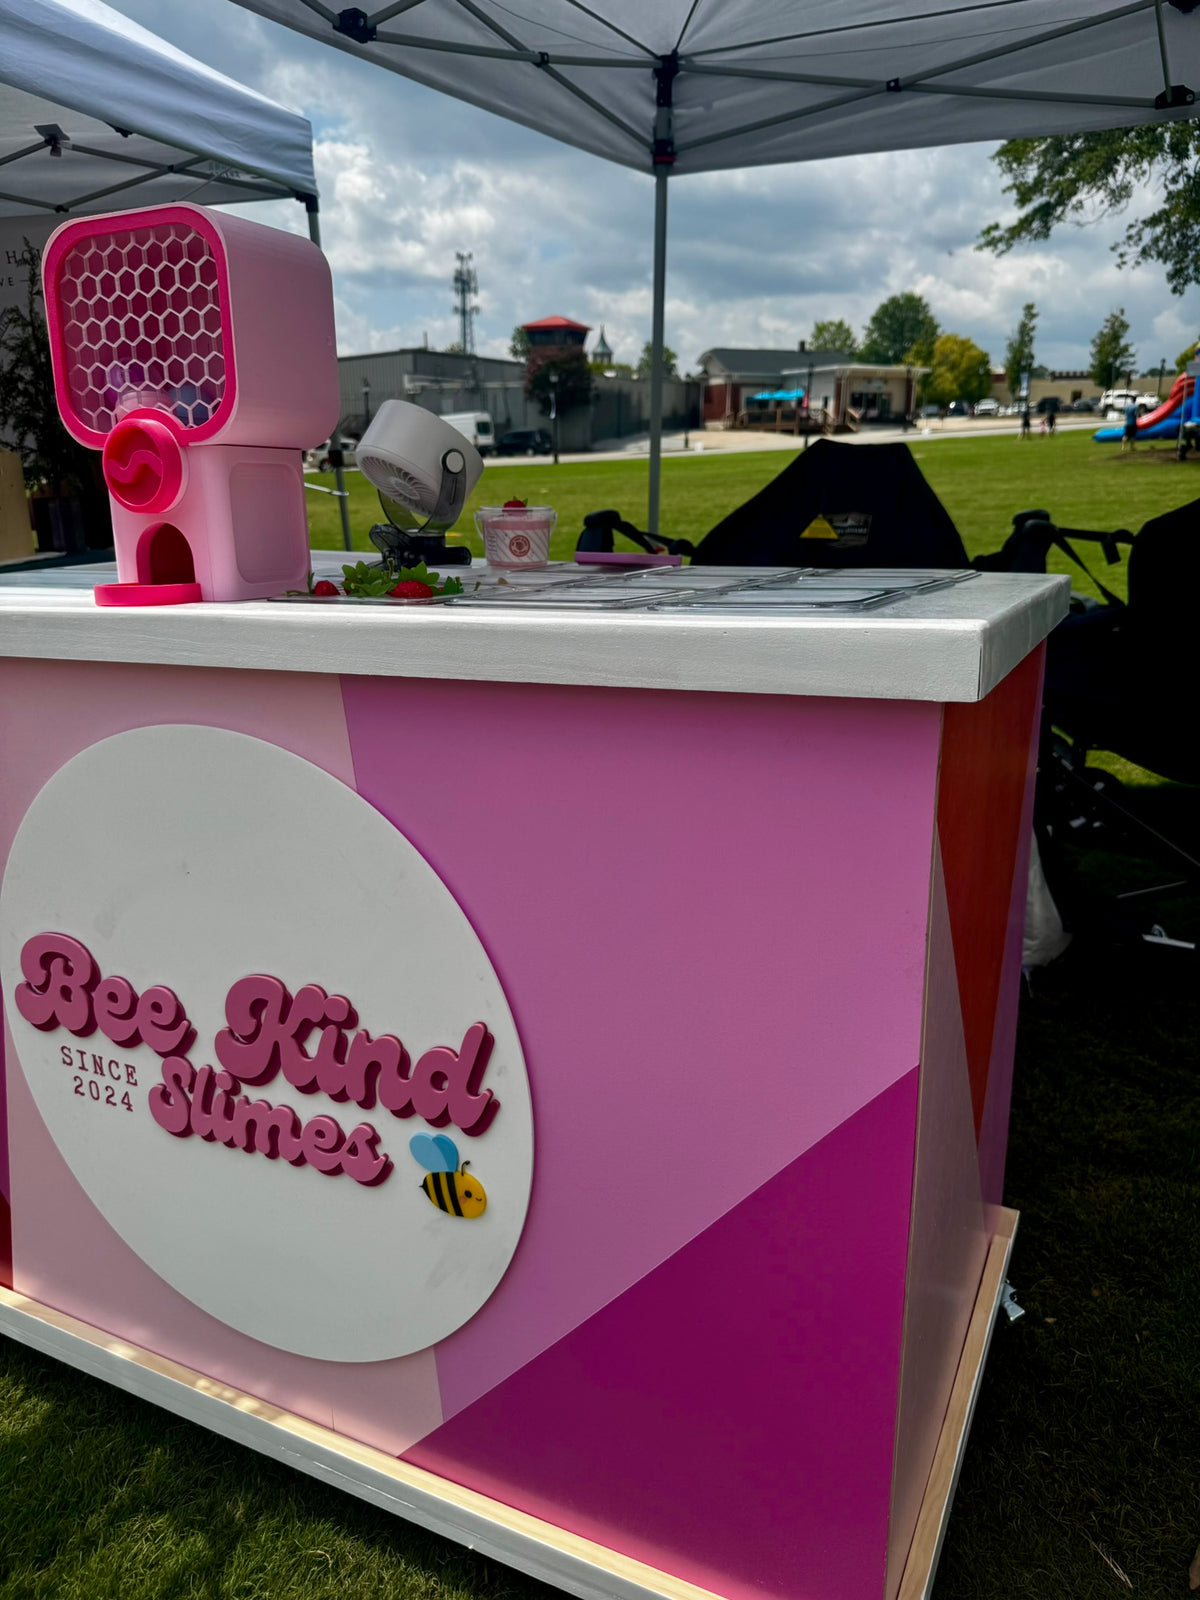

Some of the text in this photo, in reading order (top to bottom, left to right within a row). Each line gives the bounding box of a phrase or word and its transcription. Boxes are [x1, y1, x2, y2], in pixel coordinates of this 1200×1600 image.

[15, 932, 500, 1137] Bee Kind
[60, 1045, 139, 1087] SINCE
[73, 1075, 134, 1112] 2024
[148, 1056, 394, 1186] Slimes
